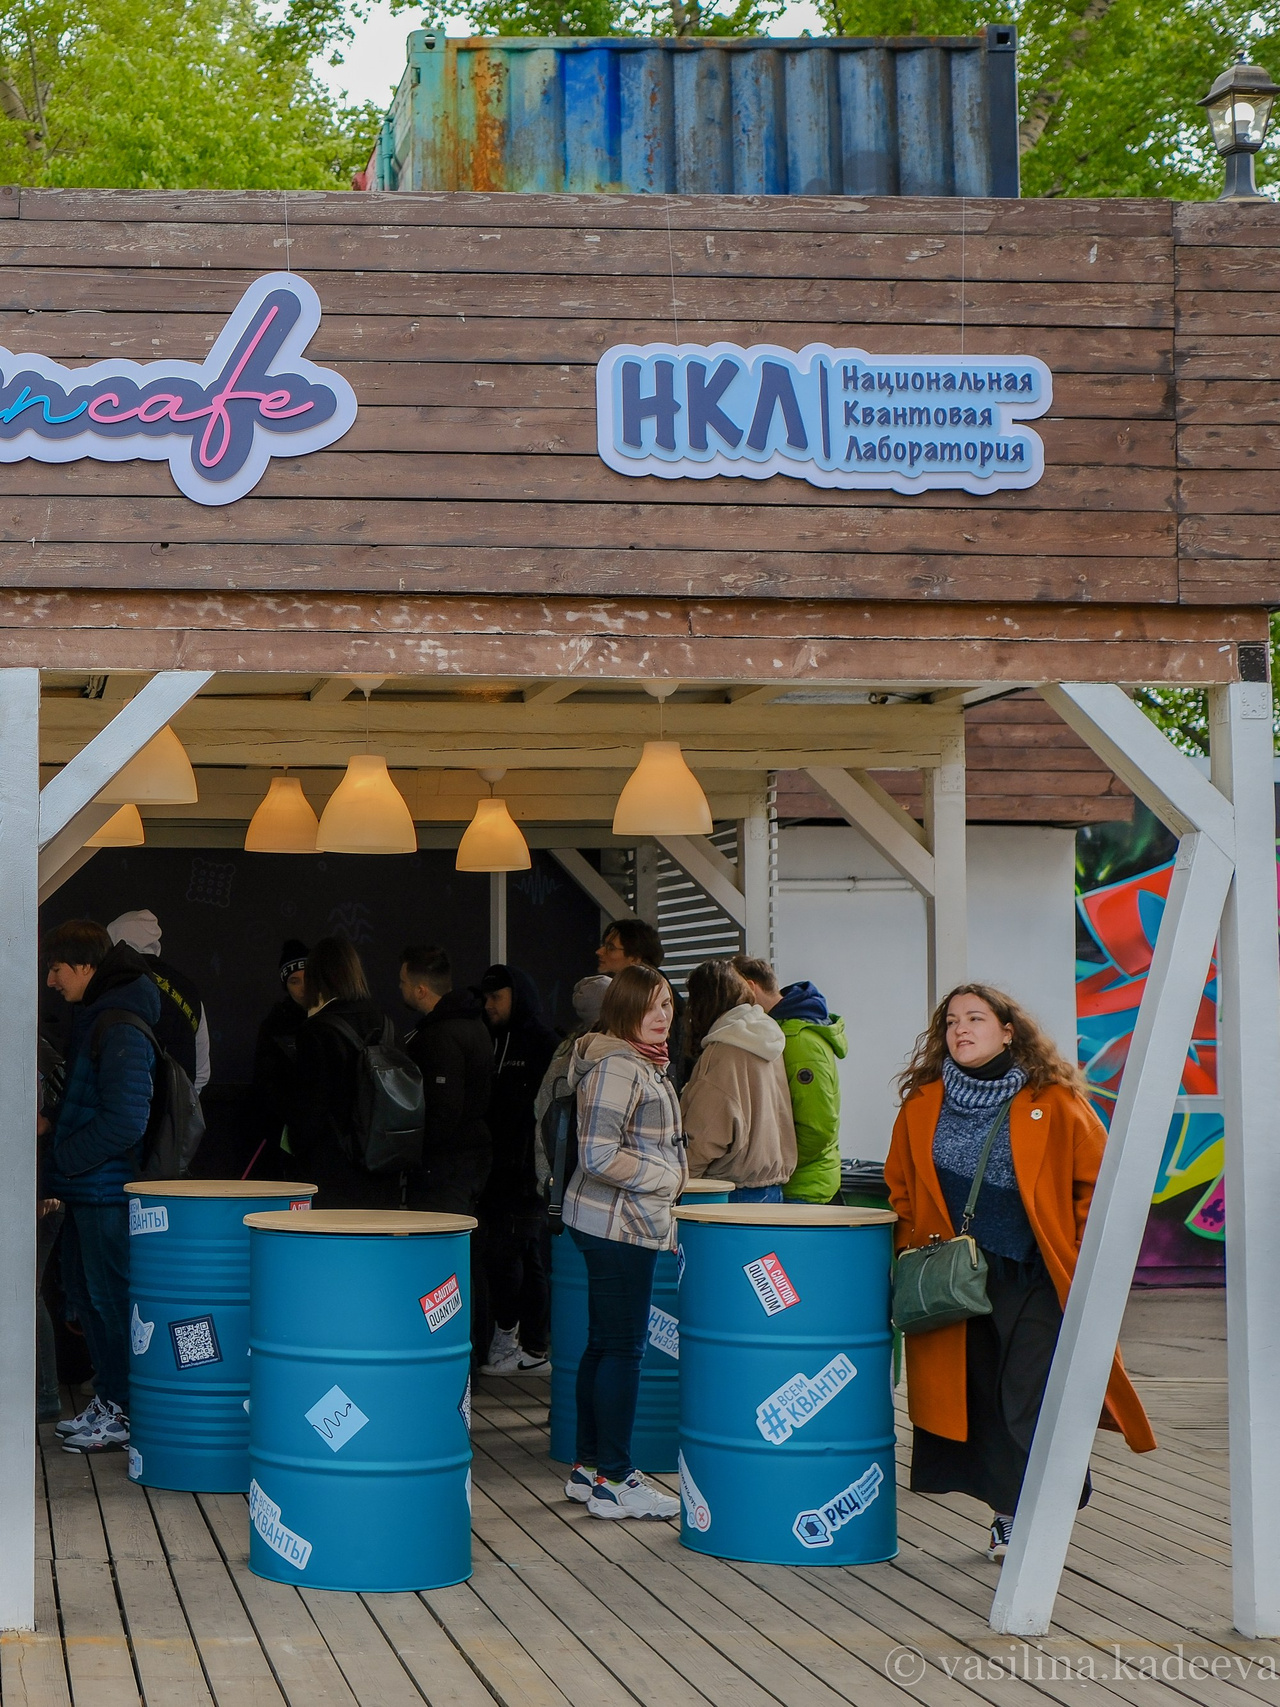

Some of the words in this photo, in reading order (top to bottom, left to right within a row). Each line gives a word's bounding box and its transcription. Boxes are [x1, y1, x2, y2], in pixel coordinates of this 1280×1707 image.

[841, 364, 1034, 397] Национальная
[622, 359, 808, 452] НКЛ
[842, 400, 993, 428] Квантовая
[844, 434, 1026, 468] Лаборатория
[433, 1277, 457, 1304] CAUTION
[748, 1263, 782, 1312] QUANTUM
[770, 1269, 797, 1305] CAUTION
[429, 1292, 461, 1327] QUANTUM
[786, 1358, 852, 1423] КВАНТЫ
[823, 1492, 861, 1527] РКЦ
[255, 1507, 307, 1564] КВАНТЫ
